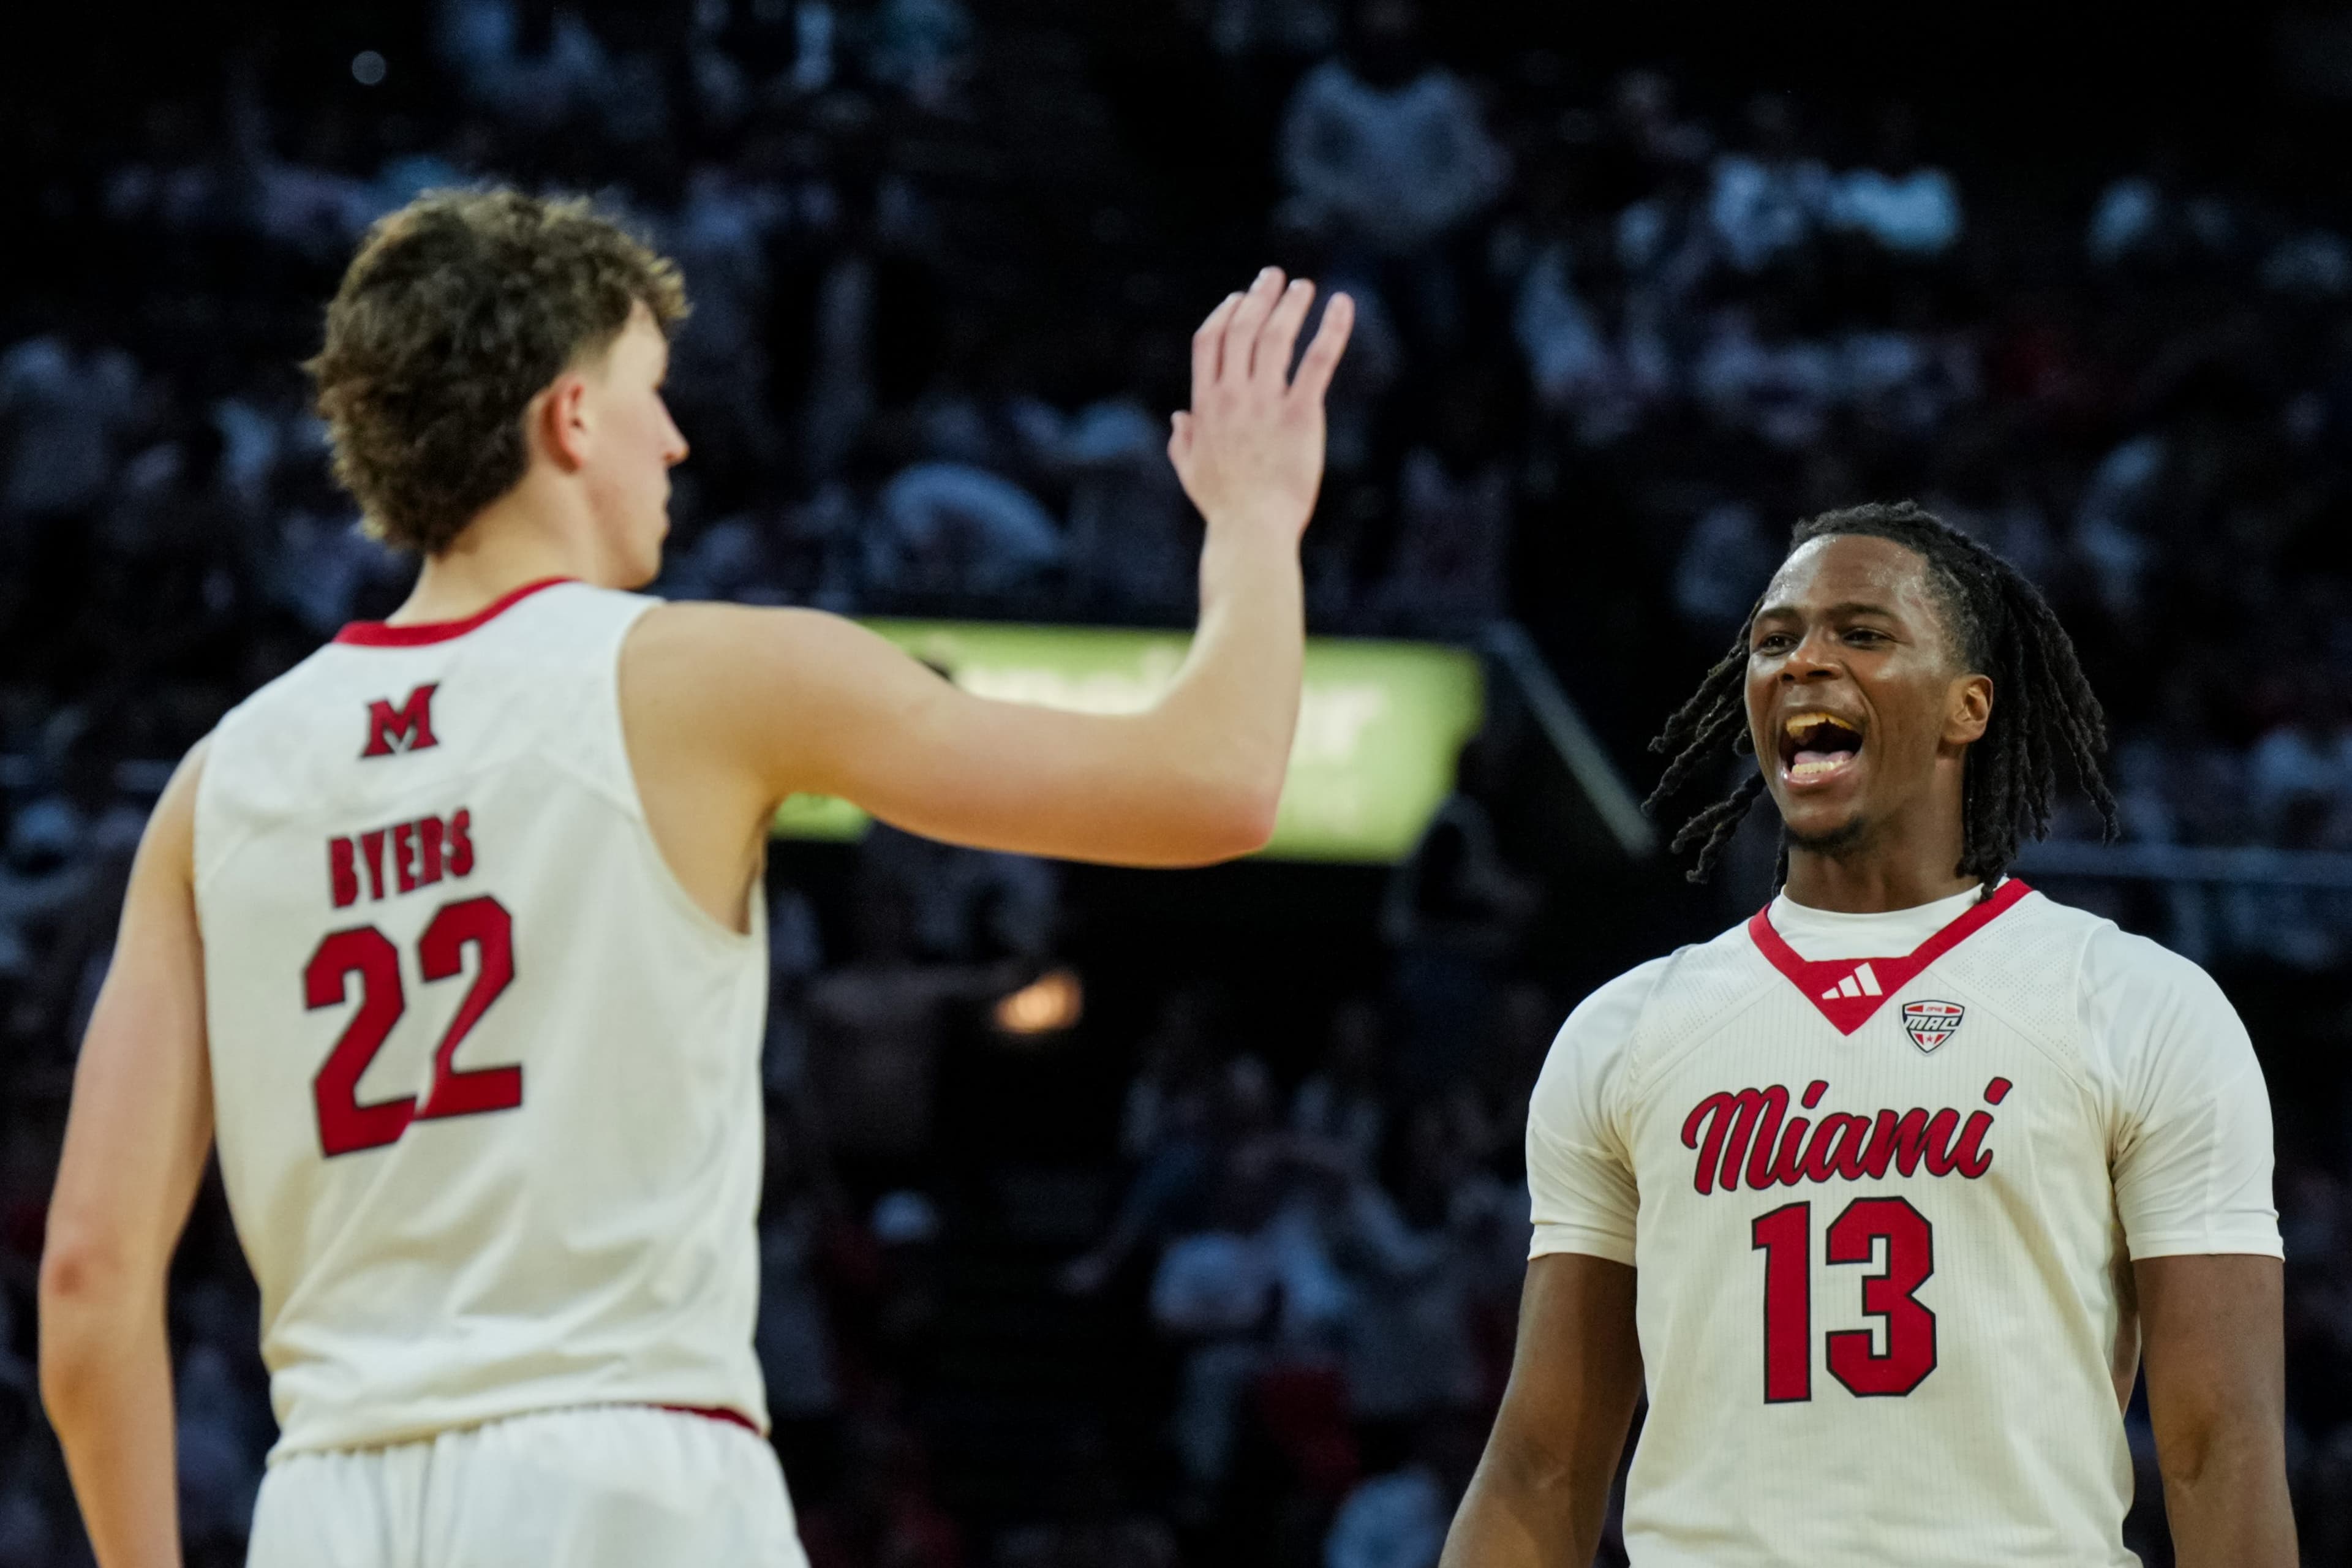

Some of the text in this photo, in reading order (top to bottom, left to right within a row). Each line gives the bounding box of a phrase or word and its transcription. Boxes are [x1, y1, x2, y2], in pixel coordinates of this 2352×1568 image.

[357, 682, 441, 758] M
[326, 806, 475, 909] BYERS
[302, 894, 522, 1158] 22
[1904, 1016, 1961, 1031] MAC
[1680, 1076, 2013, 1196] Miami
[1751, 1196, 1938, 1404] 13
